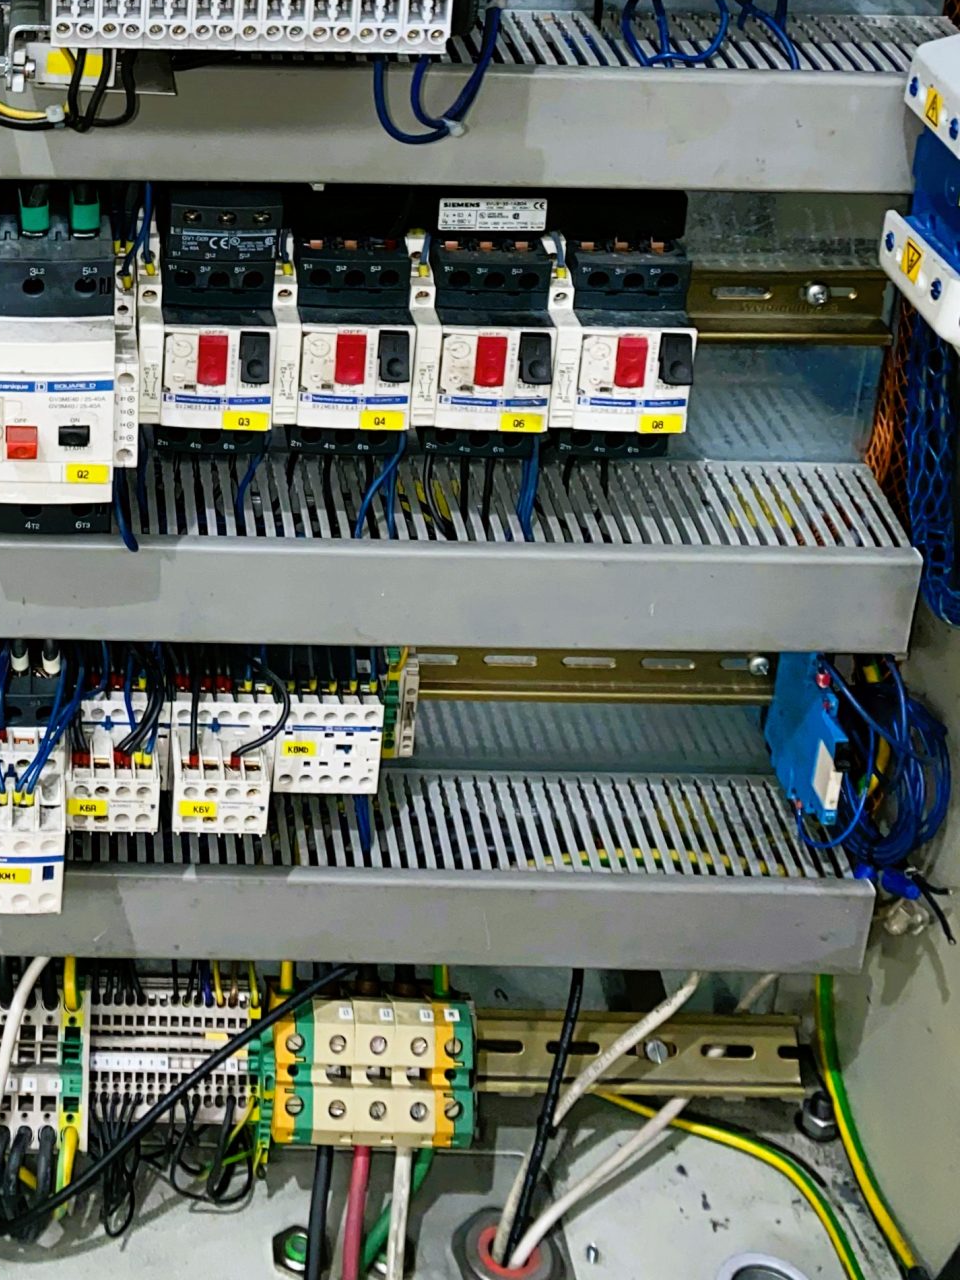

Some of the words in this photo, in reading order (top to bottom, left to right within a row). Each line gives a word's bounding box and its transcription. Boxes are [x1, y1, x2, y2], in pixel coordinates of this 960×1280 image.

[238, 417, 250, 427] Q3
[373, 416, 386, 426] Q4
[513, 419, 525, 428] Q6
[652, 420, 664, 430] Q8
[77, 470, 89, 480] Q2
[193, 804, 210, 814] K6V
